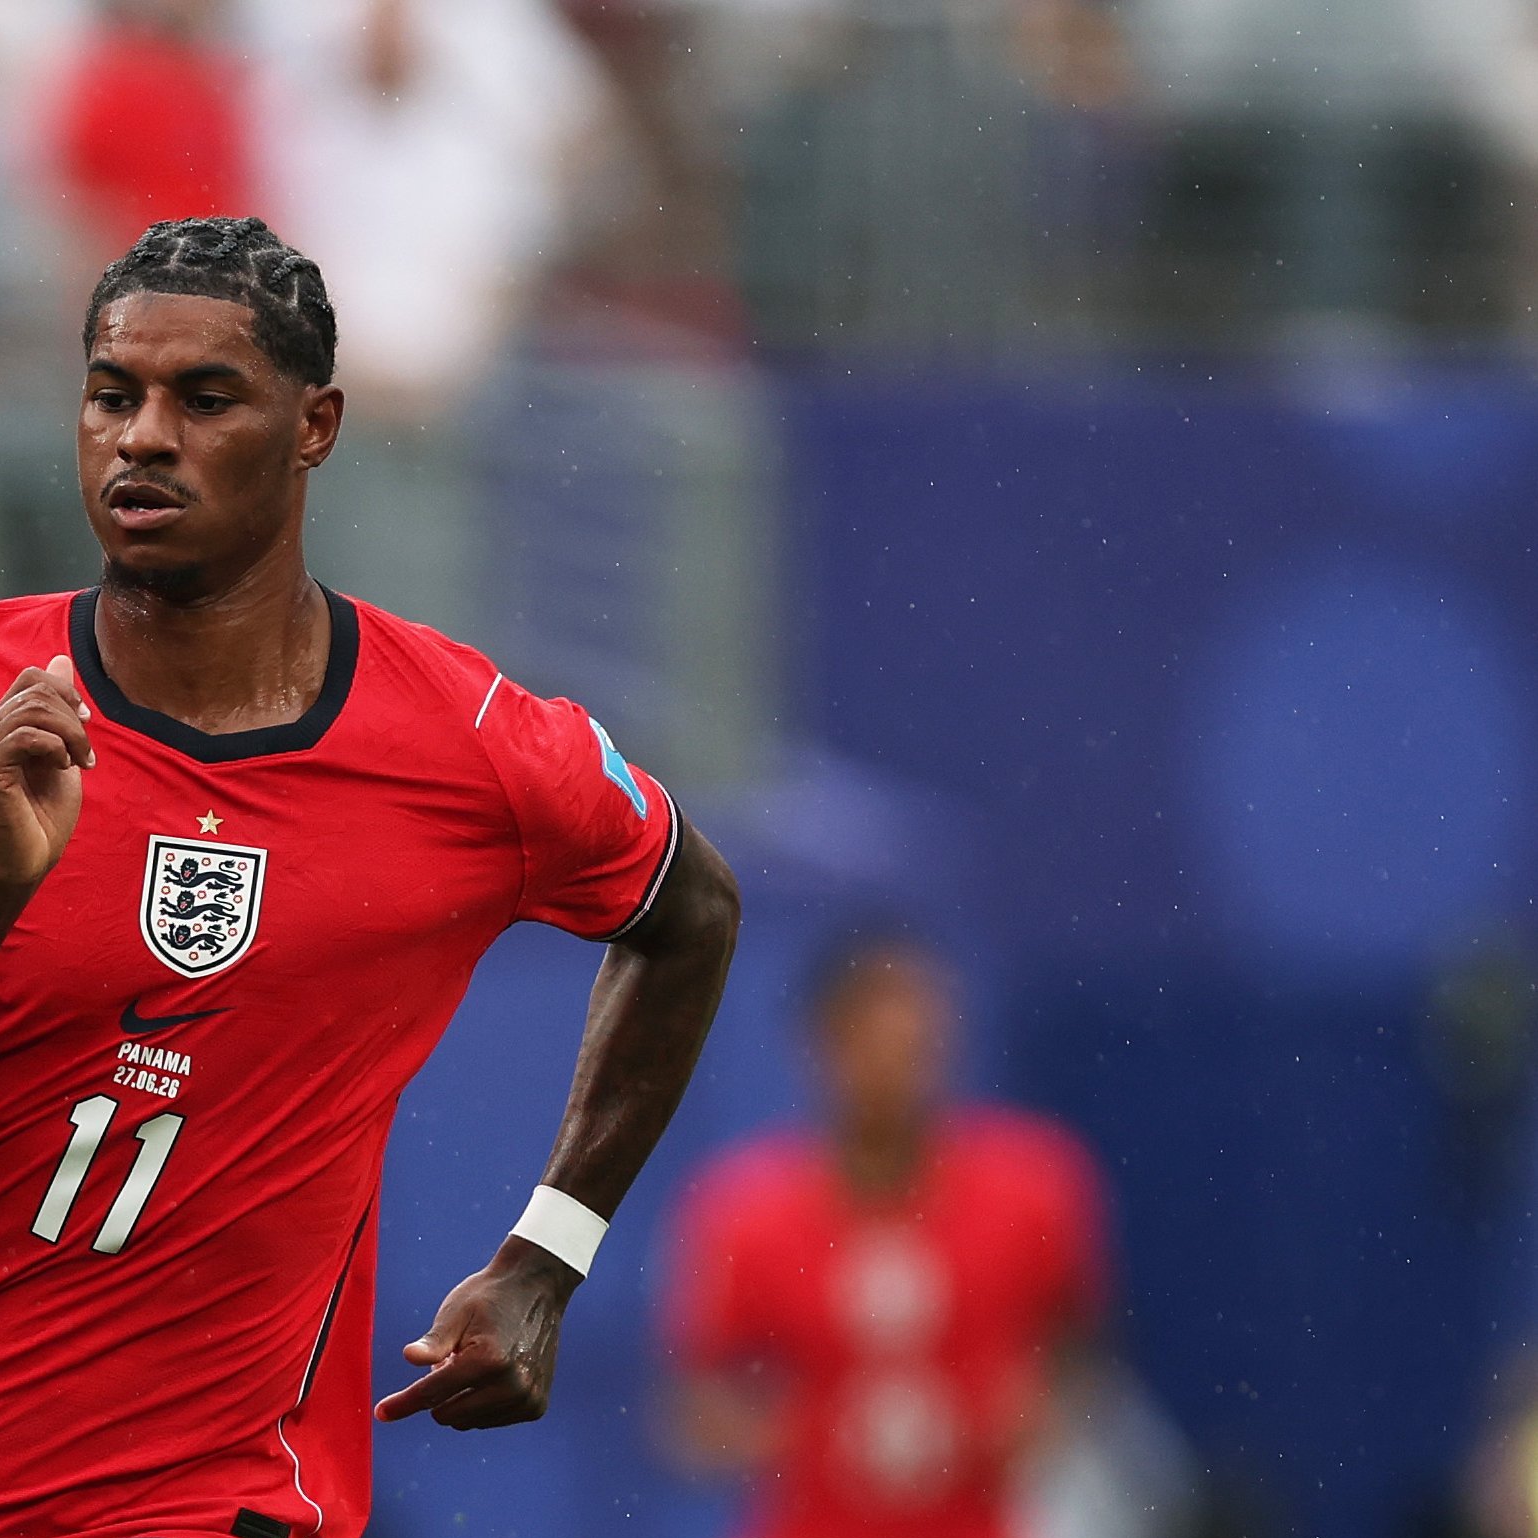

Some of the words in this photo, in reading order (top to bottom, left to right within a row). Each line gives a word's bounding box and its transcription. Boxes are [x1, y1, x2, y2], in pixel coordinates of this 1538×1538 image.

[117, 1042, 191, 1076] PANAMA
[113, 1065, 180, 1099] 27.06.26
[31, 1095, 185, 1255] 11
